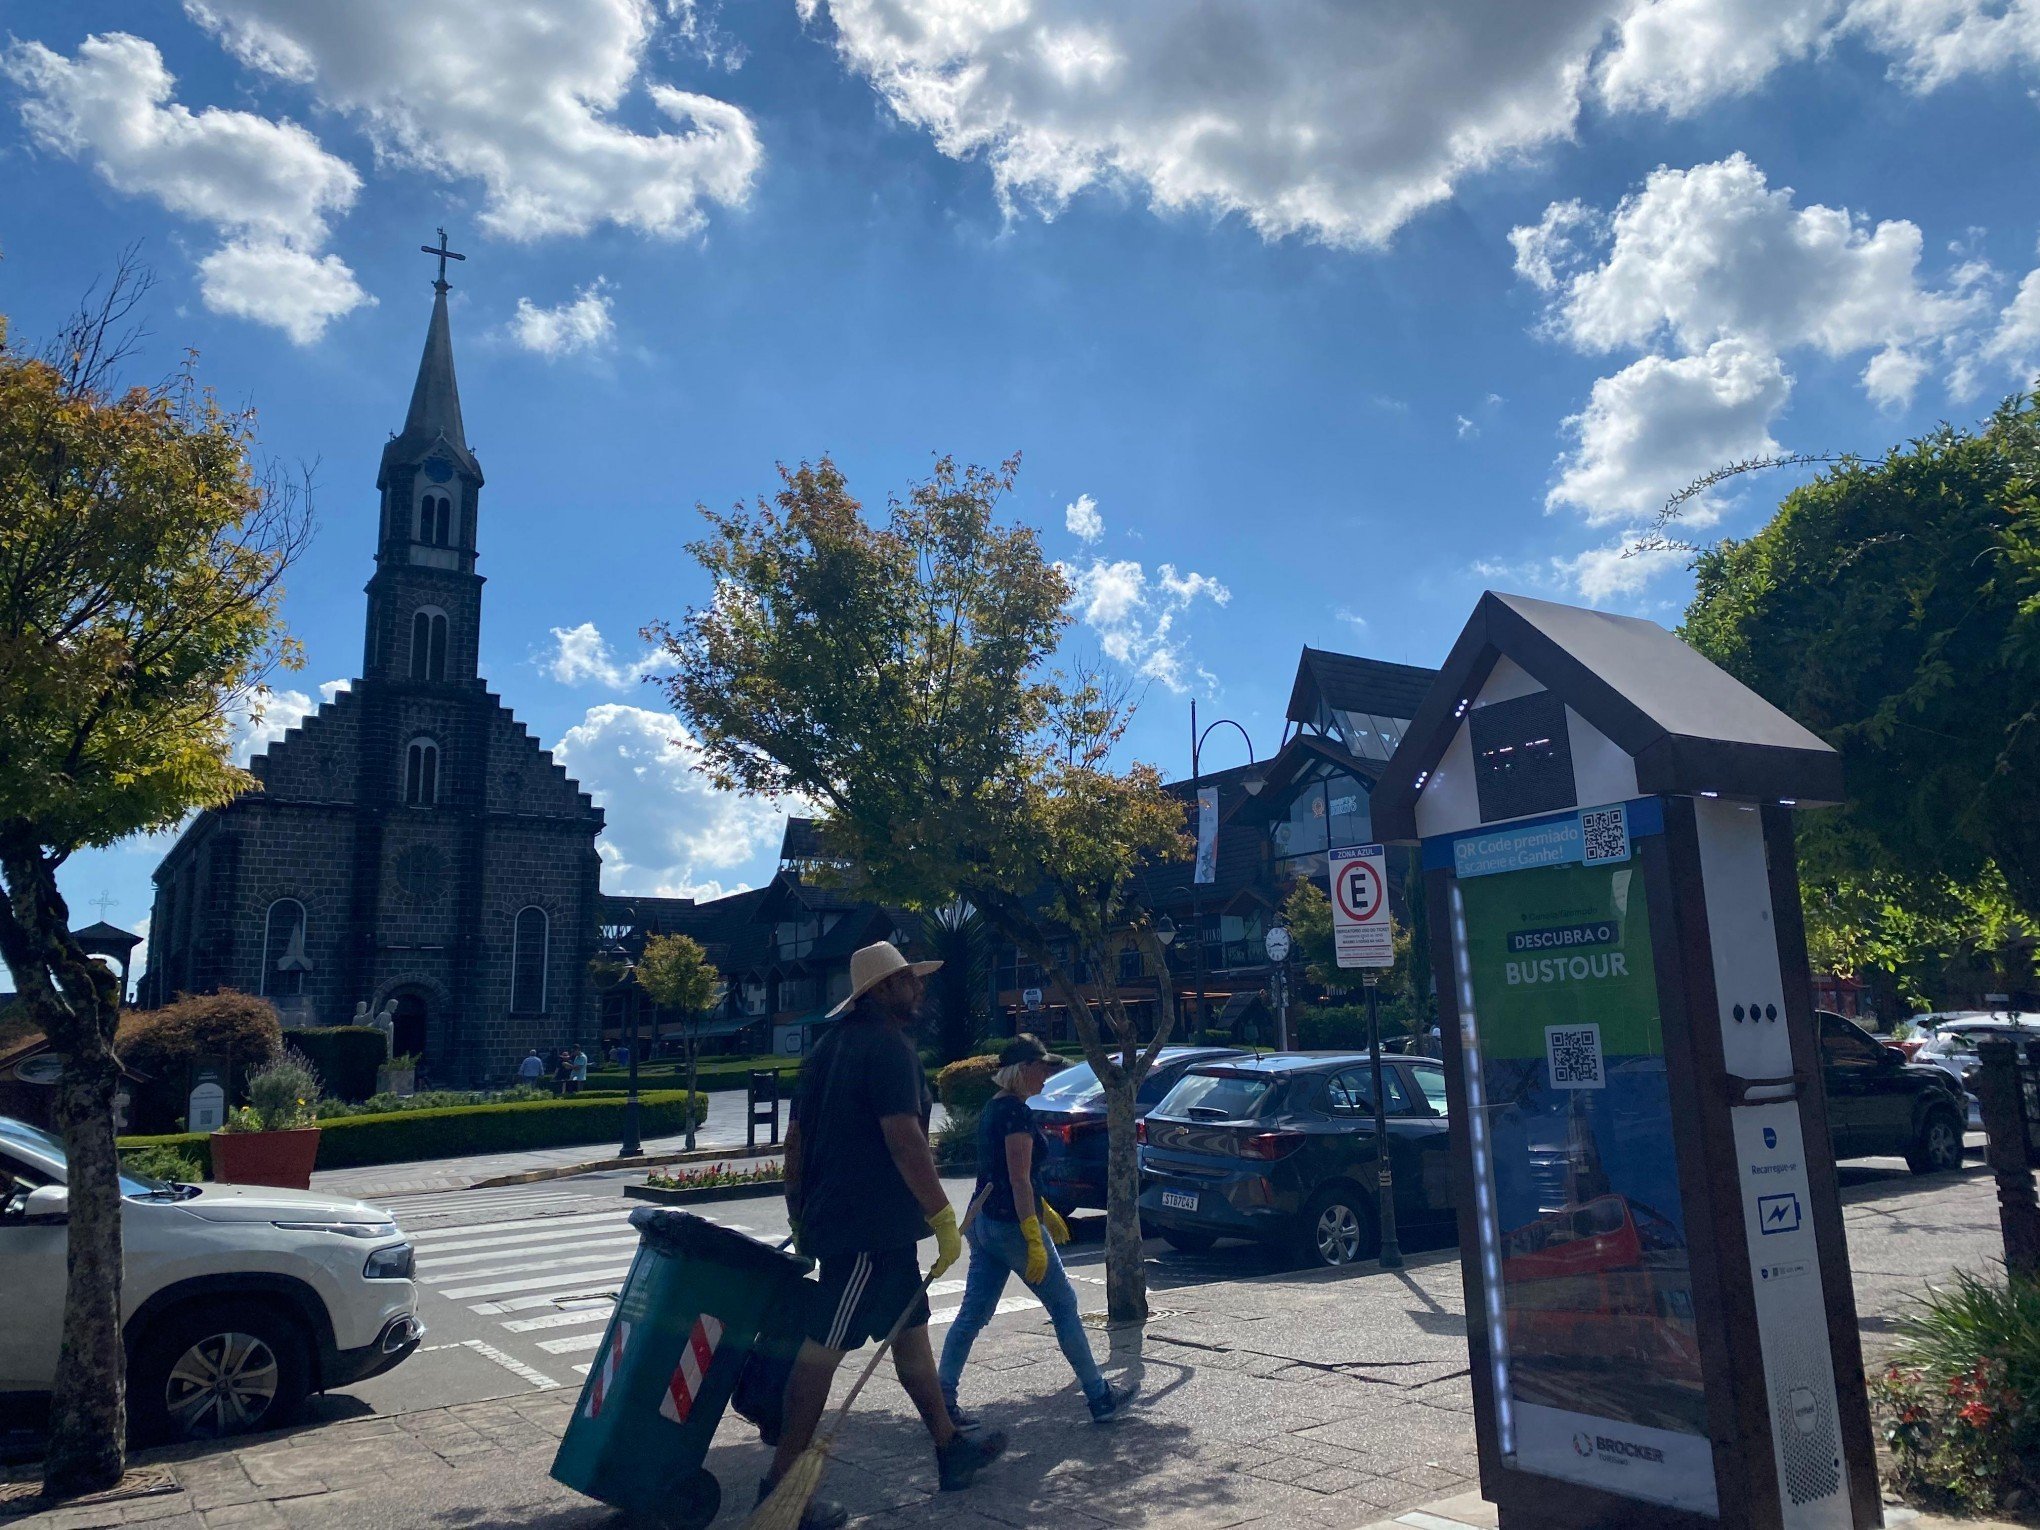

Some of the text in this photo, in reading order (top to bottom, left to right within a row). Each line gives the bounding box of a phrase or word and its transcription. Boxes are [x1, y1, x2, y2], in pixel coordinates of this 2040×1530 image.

[1337, 848, 1375, 858] ZONA AZUL
[1456, 826, 1578, 859] QR Code premiado
[1508, 857, 1516, 866] e
[1518, 847, 1564, 865] Ganhe!
[1350, 873, 1368, 908] E
[1515, 926, 1610, 949] DESCUBRA O
[1506, 952, 1629, 985] BUSTOUR
[1596, 1436, 1665, 1464] BROCKER
